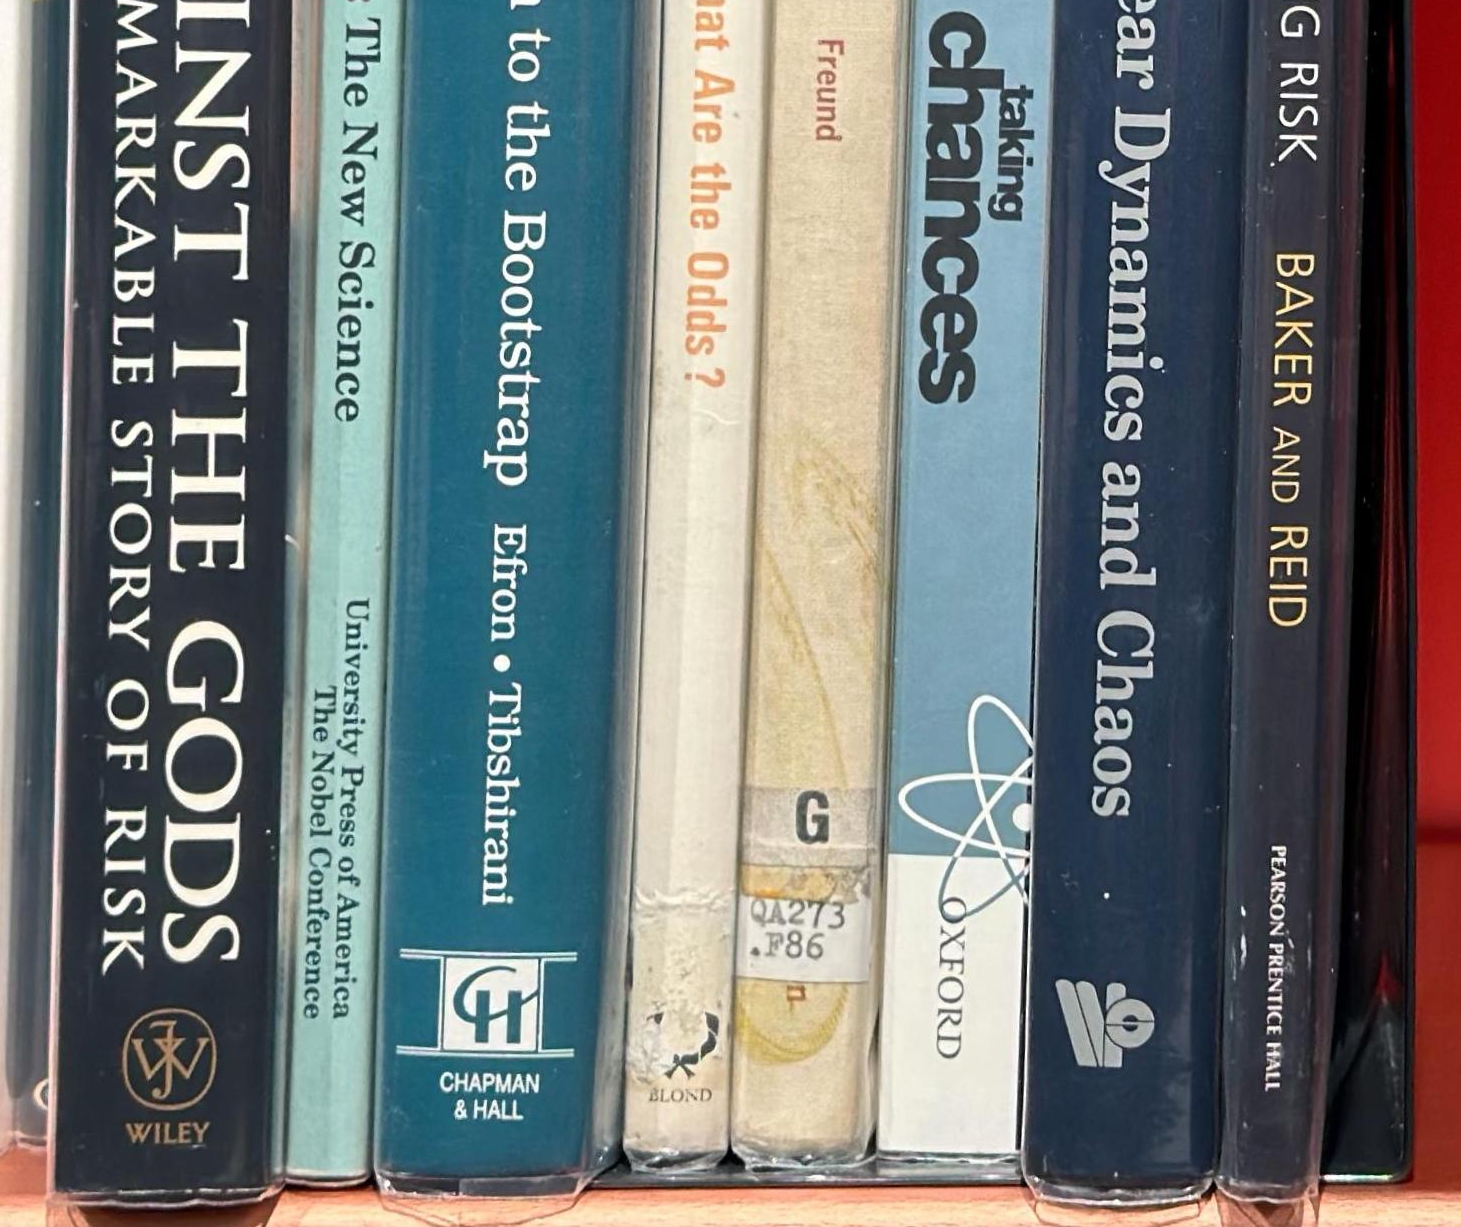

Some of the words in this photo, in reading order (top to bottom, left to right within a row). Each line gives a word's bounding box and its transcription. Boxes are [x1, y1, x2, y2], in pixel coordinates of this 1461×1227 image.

[344, 17, 381, 107] The
[508, 28, 551, 83] to
[814, 38, 845, 142] Freund
[504, 99, 551, 192] the
[693, 69, 737, 144] Are
[988, 84, 1035, 222] taking
[1276, 61, 1320, 162] RISK
[340, 122, 379, 226] New
[688, 161, 735, 234] the
[918, 11, 1005, 405] chances
[1097, 106, 1172, 443] Dynamics
[332, 240, 374, 425] Science
[482, 210, 547, 488] Bootstrap
[1271, 251, 1317, 406] BAKER
[169, 319, 247, 573] THE
[1272, 426, 1303, 505] AND
[104, 418, 154, 652] STORY
[1098, 461, 1157, 590] and
[1267, 524, 1310, 627] REID
[486, 521, 531, 643] Efron
[104, 676, 152, 772] OF
[313, 685, 337, 741] The
[338, 598, 369, 757] University
[1090, 609, 1156, 818] Chaos
[163, 621, 244, 964] GODS
[309, 751, 335, 837] Nobel
[338, 765, 364, 847] Press
[480, 681, 523, 906] Tibshirani
[795, 790, 830, 845] G
[100, 807, 149, 976] RISK
[337, 854, 360, 886] of
[750, 899, 846, 930] QA273
[1269, 845, 1287, 936] PEARSON
[303, 847, 333, 1019] Conference
[332, 891, 360, 1019] America
[750, 930, 826, 960] .F86
[935, 894, 968, 1061] OXFORD
[1266, 942, 1284, 1035] PRENTICE
[440, 1072, 540, 1094] CHAPMAN
[454, 1099, 468, 1120] &
[473, 1099, 524, 1120] HALL
[649, 1088, 712, 1102] BLOND
[1265, 1042, 1281, 1091] HALL
[125, 1119, 210, 1146] WILEY
